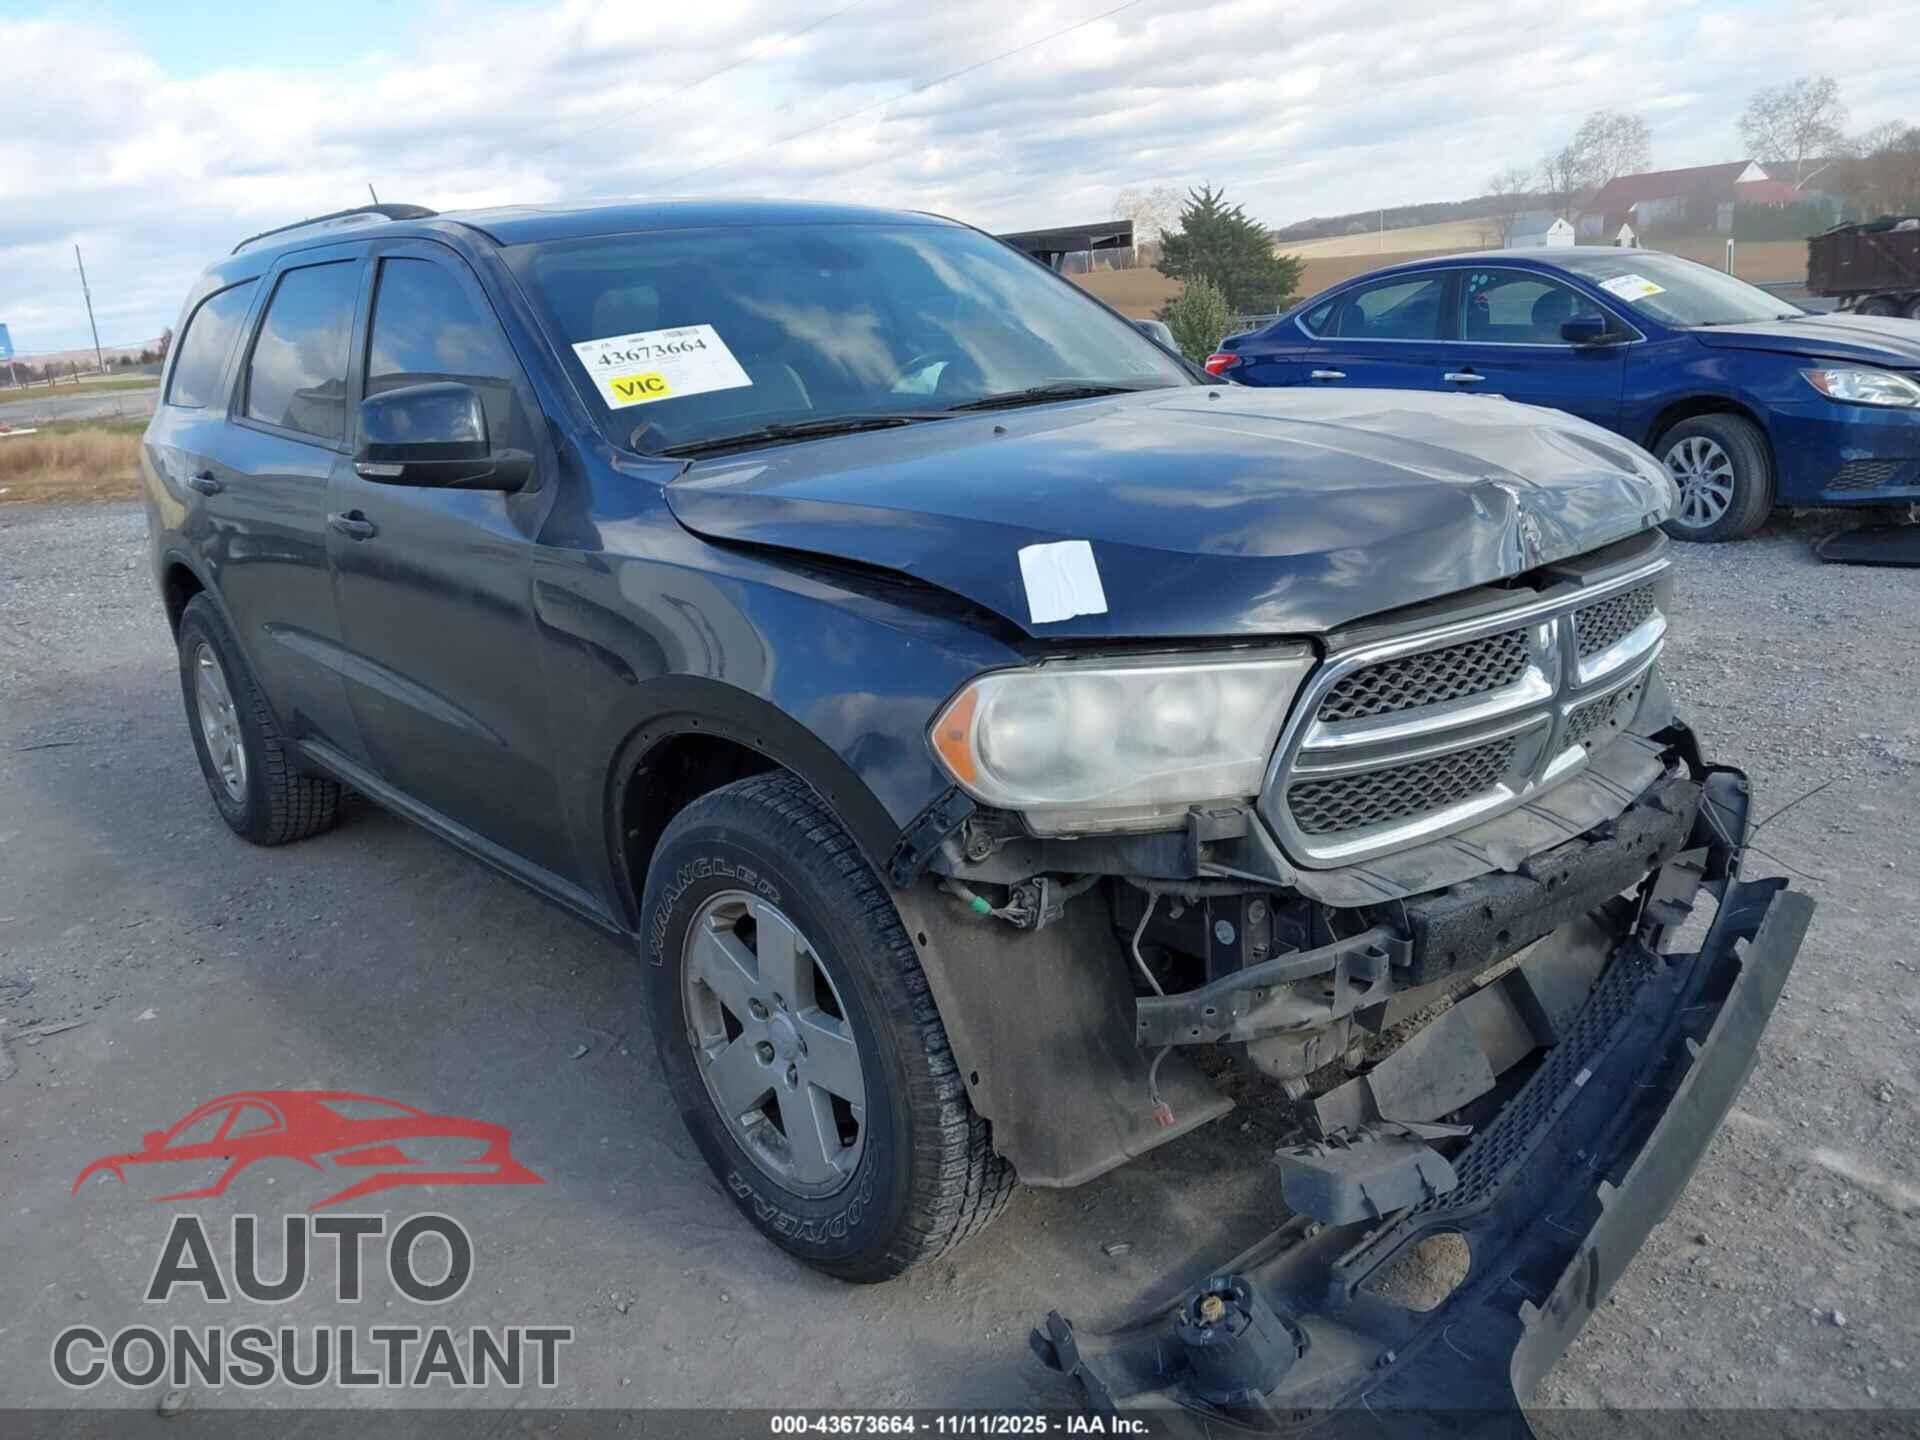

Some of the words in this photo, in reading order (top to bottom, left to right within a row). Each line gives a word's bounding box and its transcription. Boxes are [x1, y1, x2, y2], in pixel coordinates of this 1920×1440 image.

[598, 338, 707, 367] 43673664
[615, 377, 665, 397] VIC
[648, 857, 781, 968] WRANGLER
